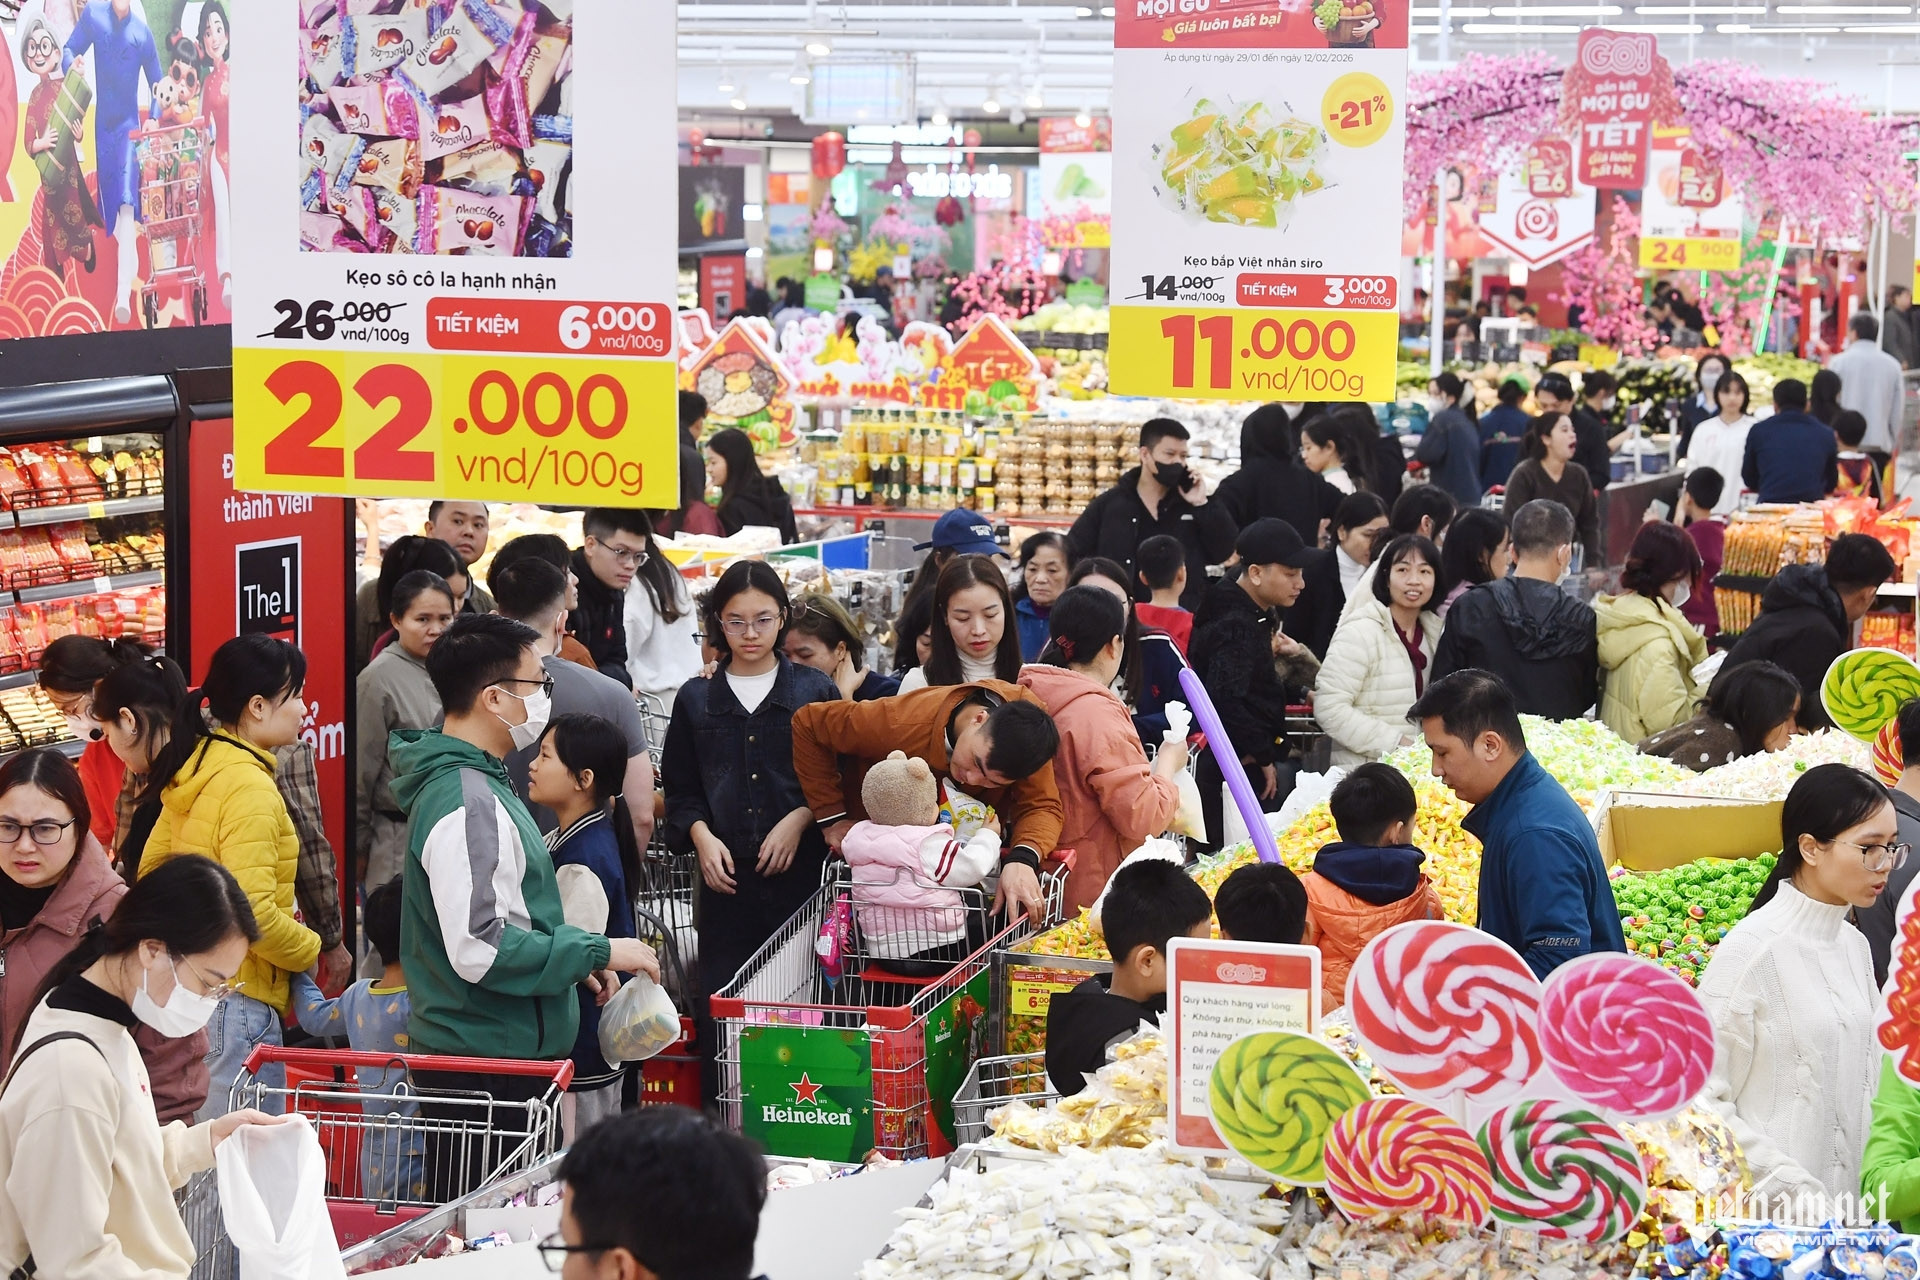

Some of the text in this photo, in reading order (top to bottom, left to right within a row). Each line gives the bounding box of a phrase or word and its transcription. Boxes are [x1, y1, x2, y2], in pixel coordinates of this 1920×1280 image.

[1175, 12, 1282, 34] Giá luôn bất bại
[1164, 52, 1354, 64] Áp dụng từ ngày 29/01 đến ngày 12/02/2026
[1582, 36, 1652, 75] GO!
[1329, 95, 1386, 130] -21%
[1581, 93, 1650, 115] MỌI GU
[1585, 112, 1643, 147] TẾT
[1184, 254, 1323, 269] Kẹo bắp Việt nhân siro
[1652, 242, 1687, 265] 24
[346, 269, 556, 292] Kẹo sô cô la hạnh nhận
[1242, 282, 1297, 298] TIẾT KIỆM
[1180, 291, 1225, 304] vnd/100g
[1349, 294, 1391, 307] vnd/100g
[435, 312, 519, 336] TIẾT KIỆM
[341, 327, 410, 344] vnd/100g
[600, 333, 663, 352] vnd/100g
[1242, 365, 1364, 397] vnd/100g
[456, 445, 643, 496] vnd/100g
[223, 493, 273, 523] thành
[1203, 997, 1229, 1006] khách
[1231, 1000, 1254, 1009] hàng
[1192, 1013, 1221, 1023] Không
[762, 1105, 852, 1126] Heineken
